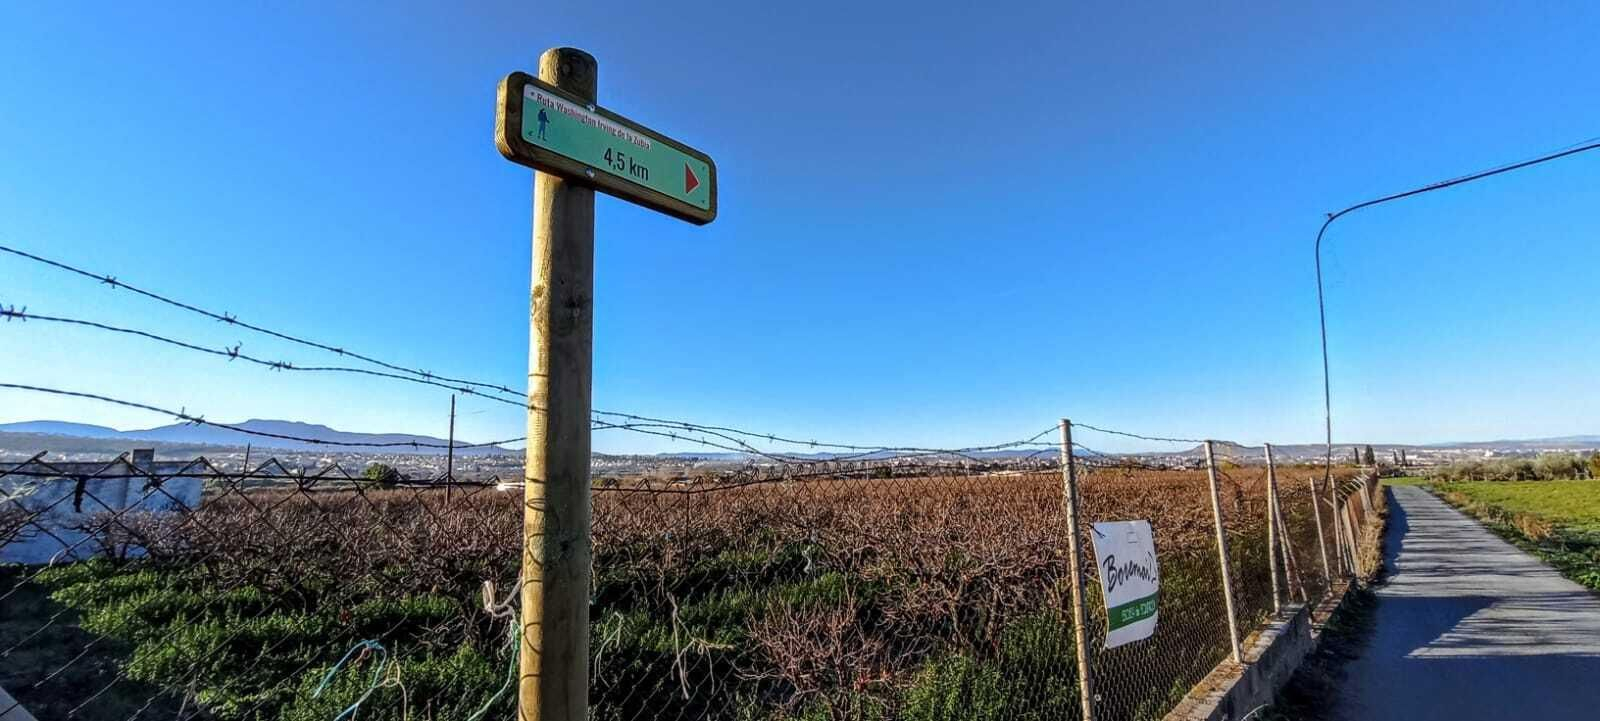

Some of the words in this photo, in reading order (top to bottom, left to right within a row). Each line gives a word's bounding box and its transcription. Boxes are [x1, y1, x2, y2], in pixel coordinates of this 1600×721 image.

[536, 93, 555, 109] Ruta
[556, 101, 598, 127] Washington
[597, 120, 616, 136] Irving
[617, 128, 626, 138] de
[633, 135, 650, 149] Zubia
[604, 147, 625, 171] 4,5
[629, 156, 649, 181] km
